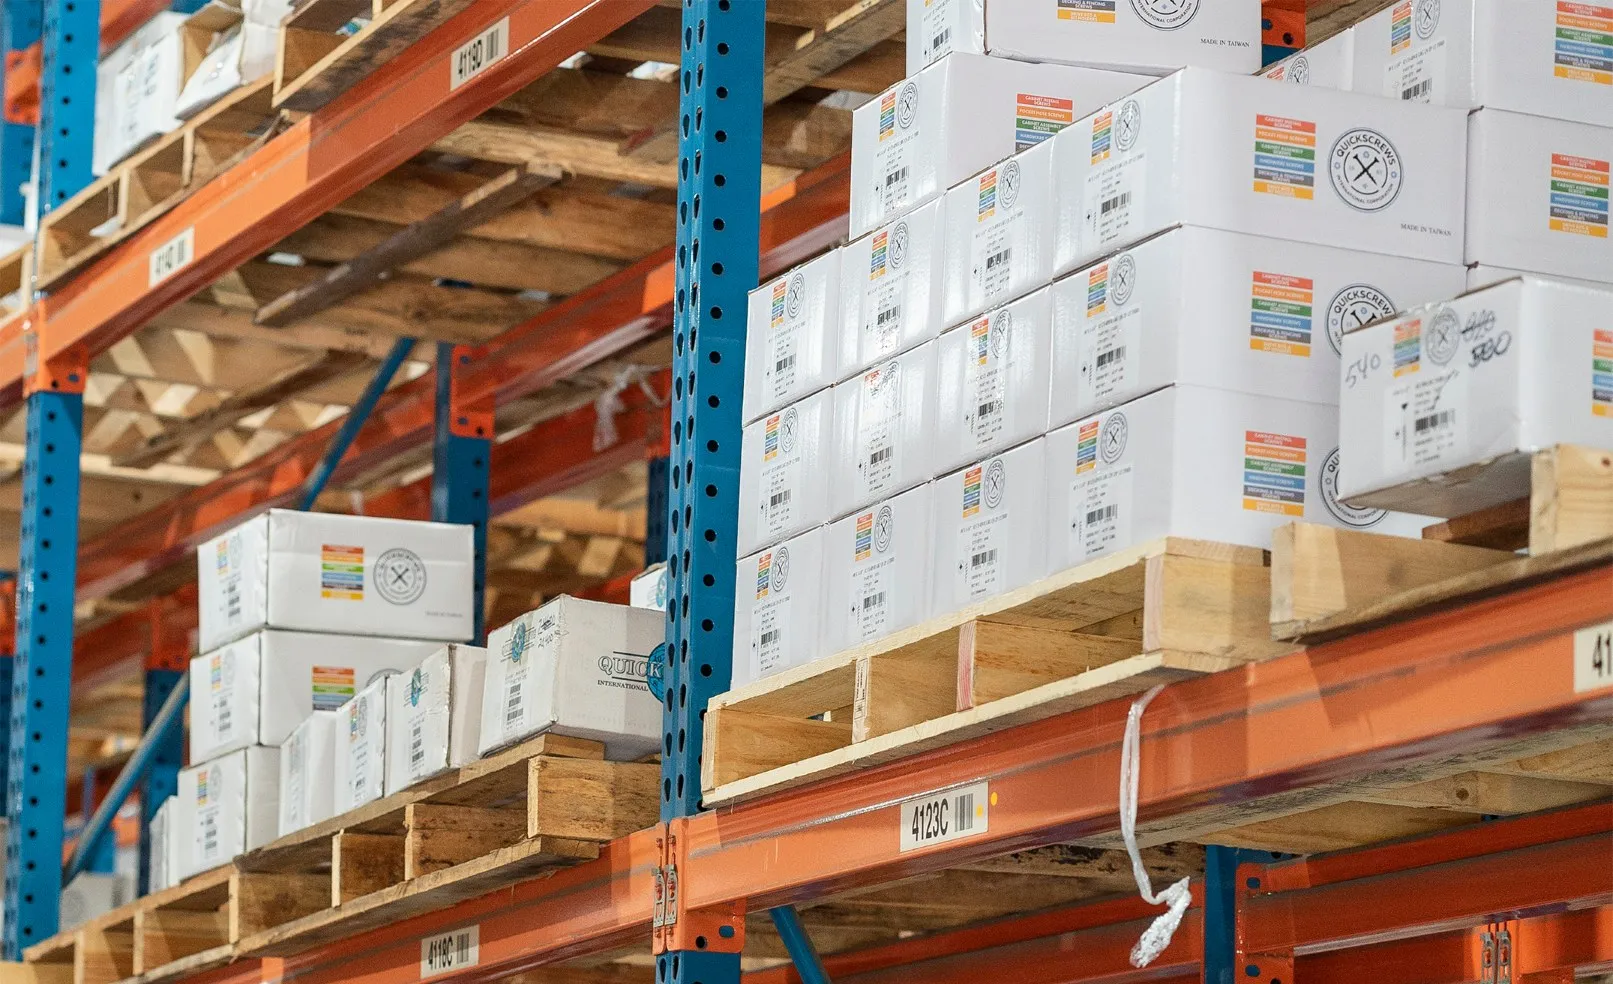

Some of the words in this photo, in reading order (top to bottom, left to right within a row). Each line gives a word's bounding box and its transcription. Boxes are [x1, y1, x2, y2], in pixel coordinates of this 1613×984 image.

[1228, 40, 1250, 48] TAIWAN
[1336, 134, 1396, 166] QUICKSCREWS
[1401, 223, 1418, 232] MADE
[1420, 226, 1428, 234] IN
[1429, 227, 1452, 236] TAIWAN
[597, 680, 649, 692] INTERNATIONAL
[912, 798, 949, 841] 4123C
